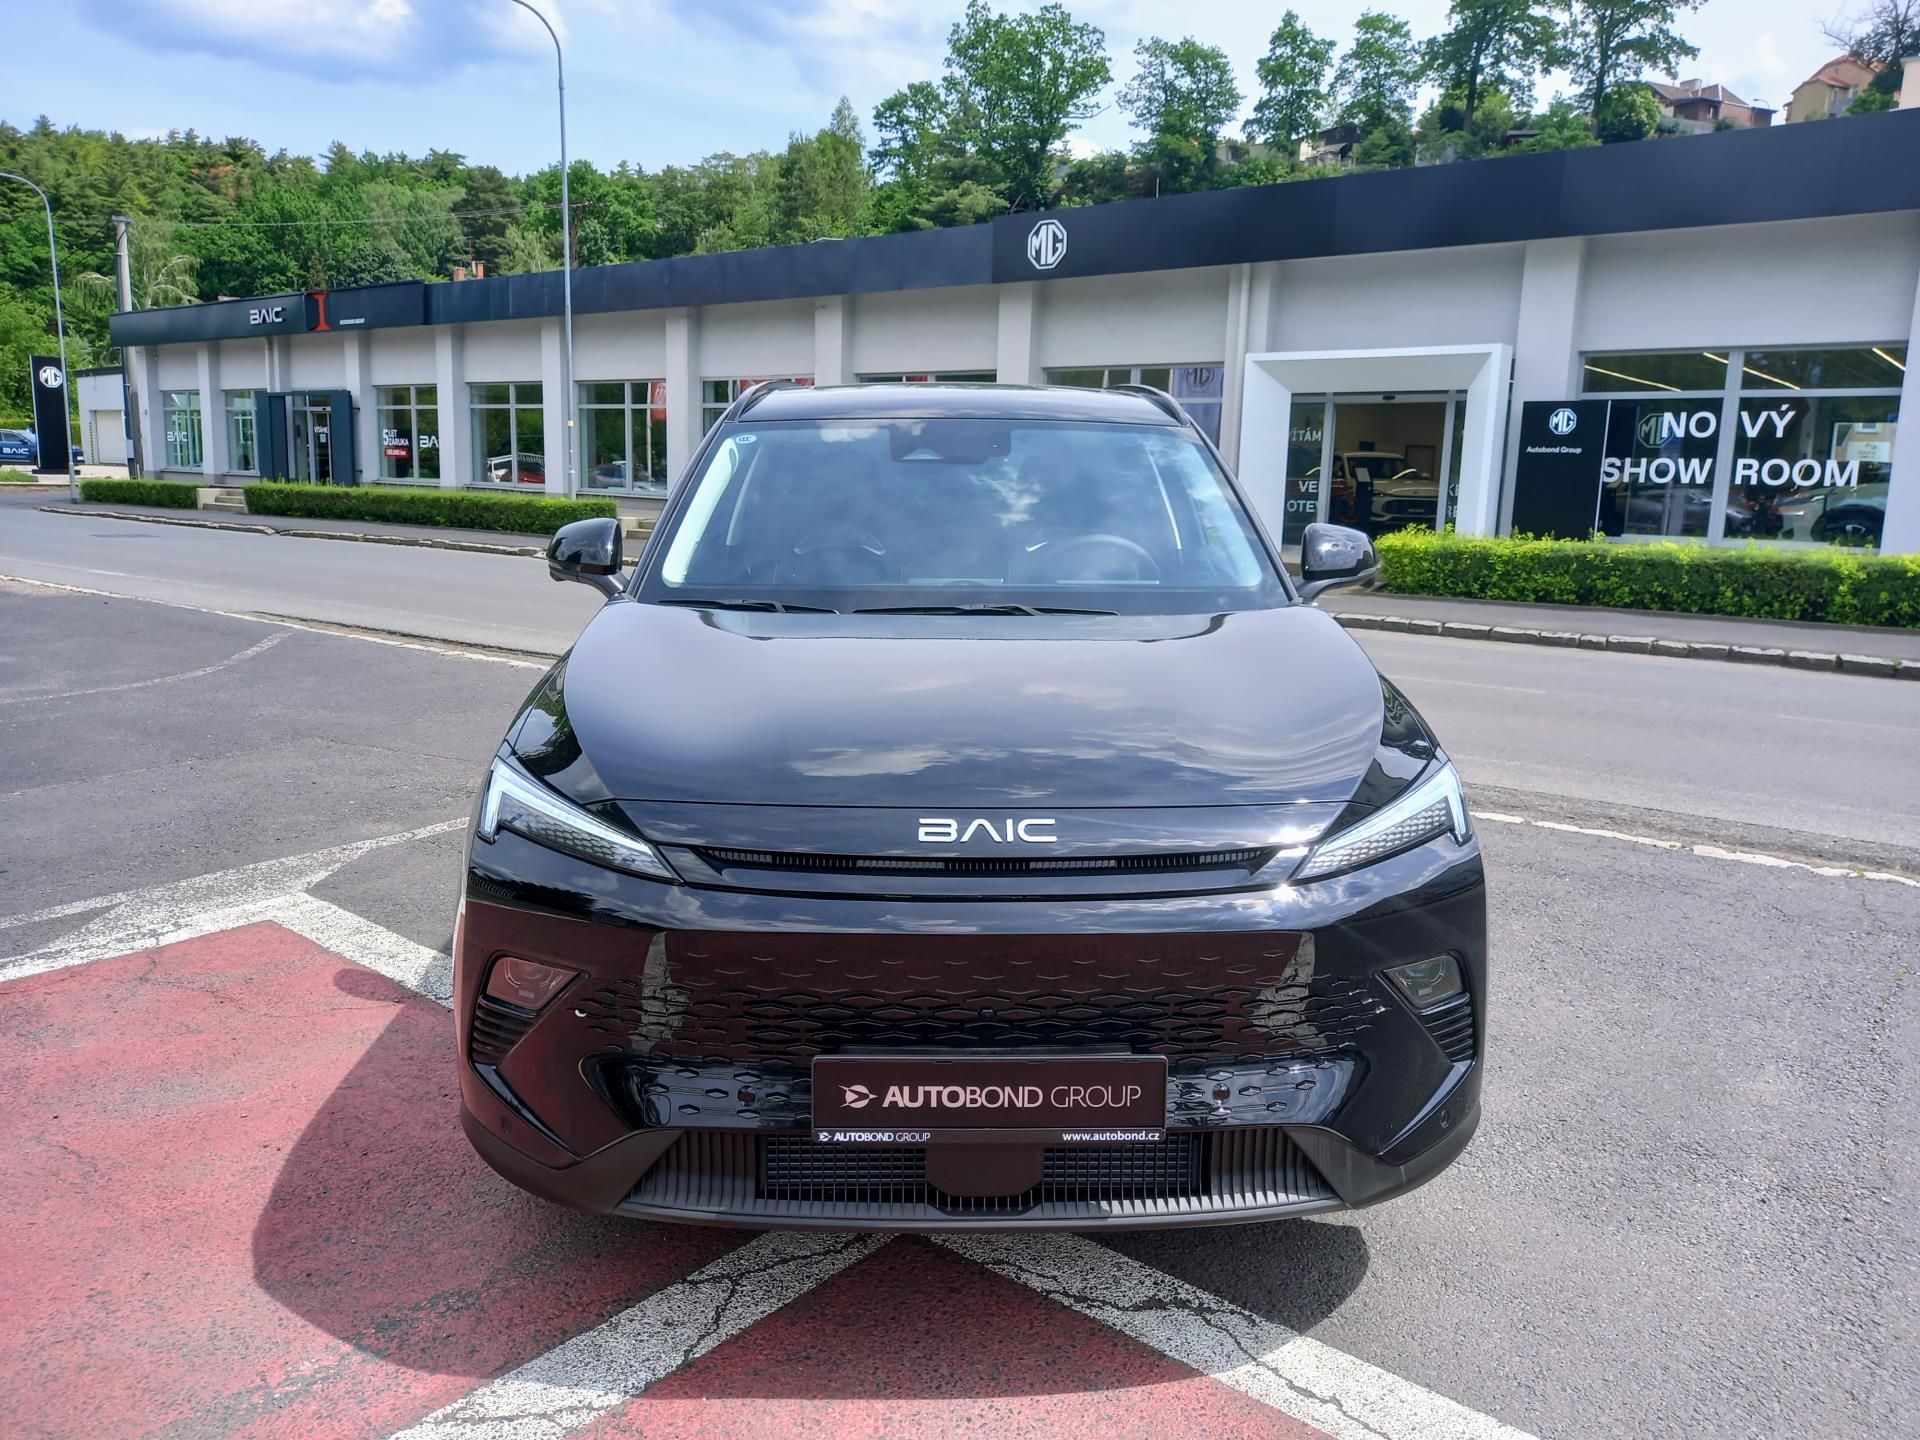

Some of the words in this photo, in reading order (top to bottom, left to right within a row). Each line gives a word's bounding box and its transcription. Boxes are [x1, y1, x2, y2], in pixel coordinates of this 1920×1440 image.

[1031, 222, 1064, 266] MG
[249, 306, 283, 325] BAIC
[41, 367, 61, 387] MG
[1551, 410, 1575, 433] MG
[2, 447, 30, 455] BAIC
[1525, 445, 1560, 454] Autobond
[1560, 446, 1583, 455] Group
[1734, 458, 1861, 488] ROOM
[918, 818, 1058, 843] BAIC
[882, 1085, 1043, 1109] AUTOBOND
[1050, 1085, 1142, 1109] GROUP
[833, 1132, 894, 1142] AUTOBOND
[895, 1132, 931, 1142] GROUP
[1062, 1131, 1161, 1142] www.autobond.cz
